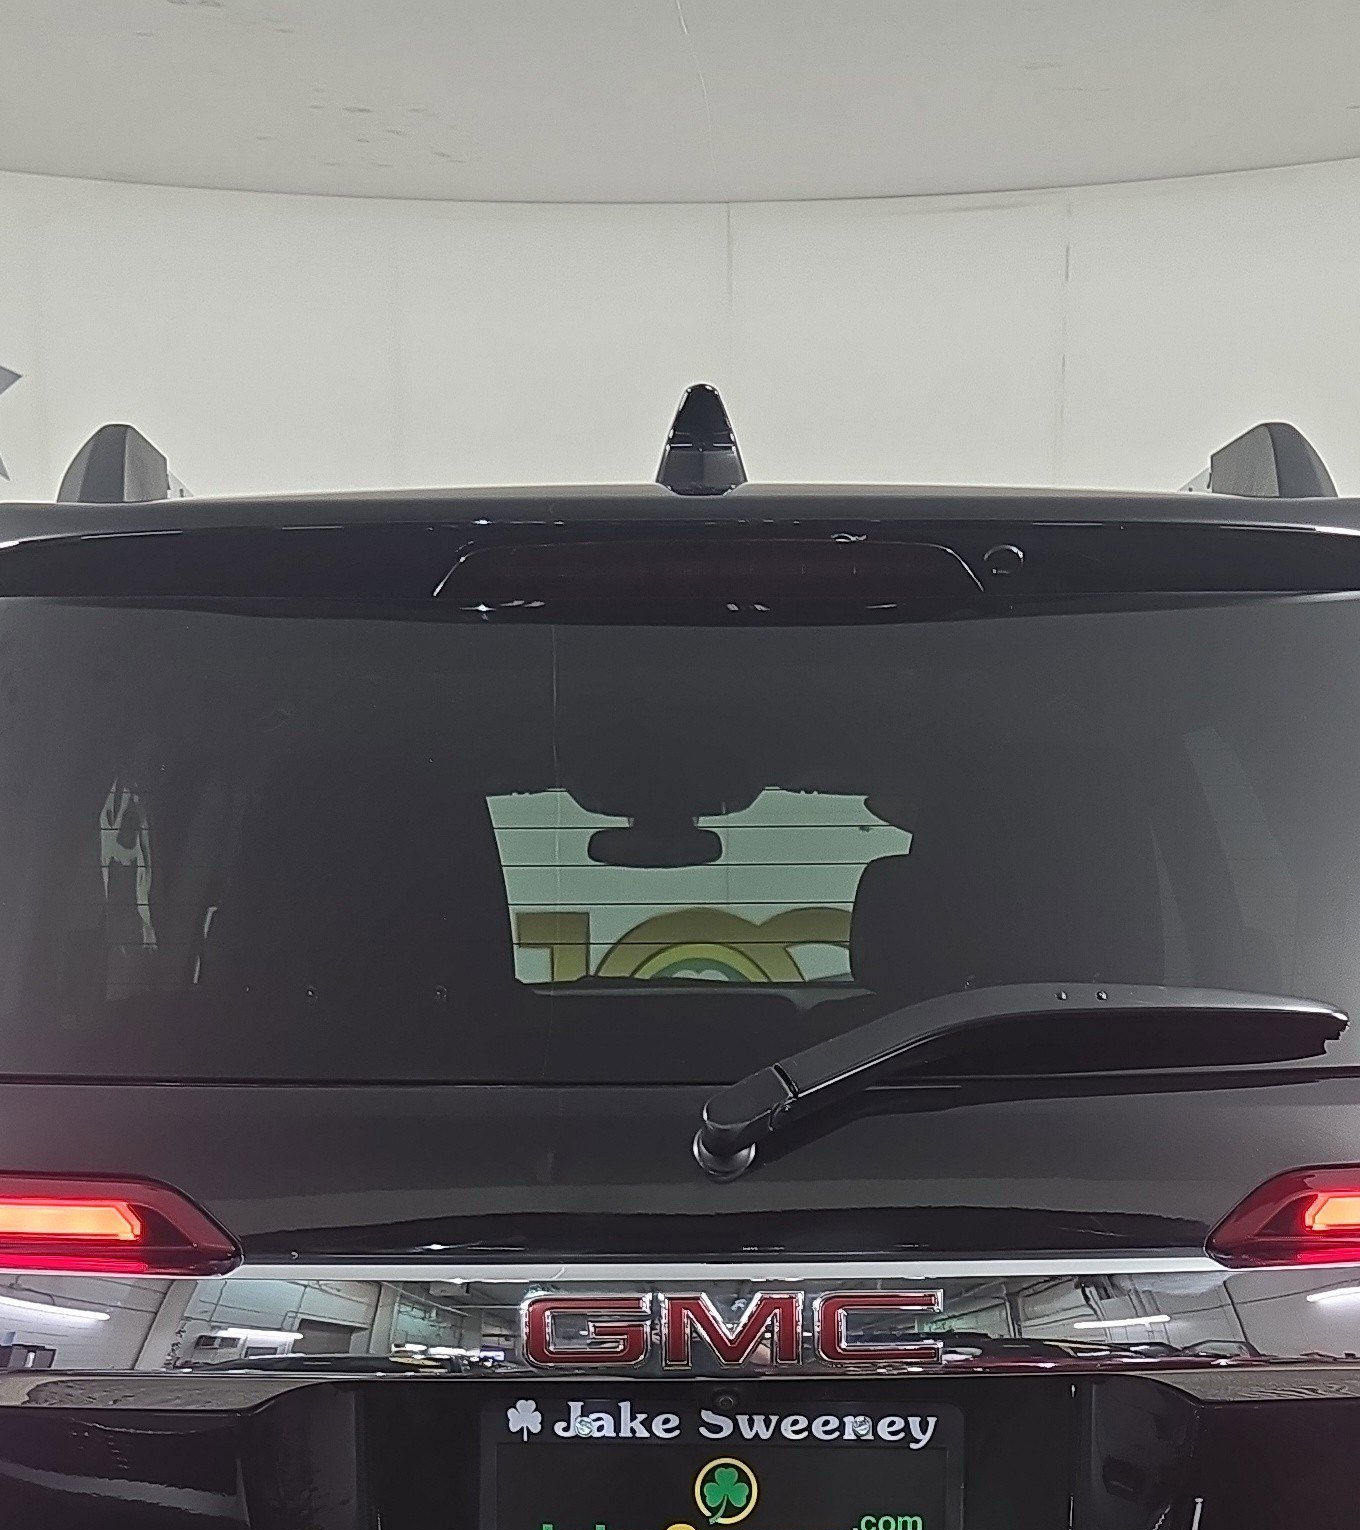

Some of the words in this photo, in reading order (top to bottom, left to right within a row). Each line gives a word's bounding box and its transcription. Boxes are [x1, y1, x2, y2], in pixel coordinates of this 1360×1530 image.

[519, 1288, 945, 1371] GMC
[553, 1401, 681, 1440] Jake
[698, 1408, 938, 1451] Sweeney
